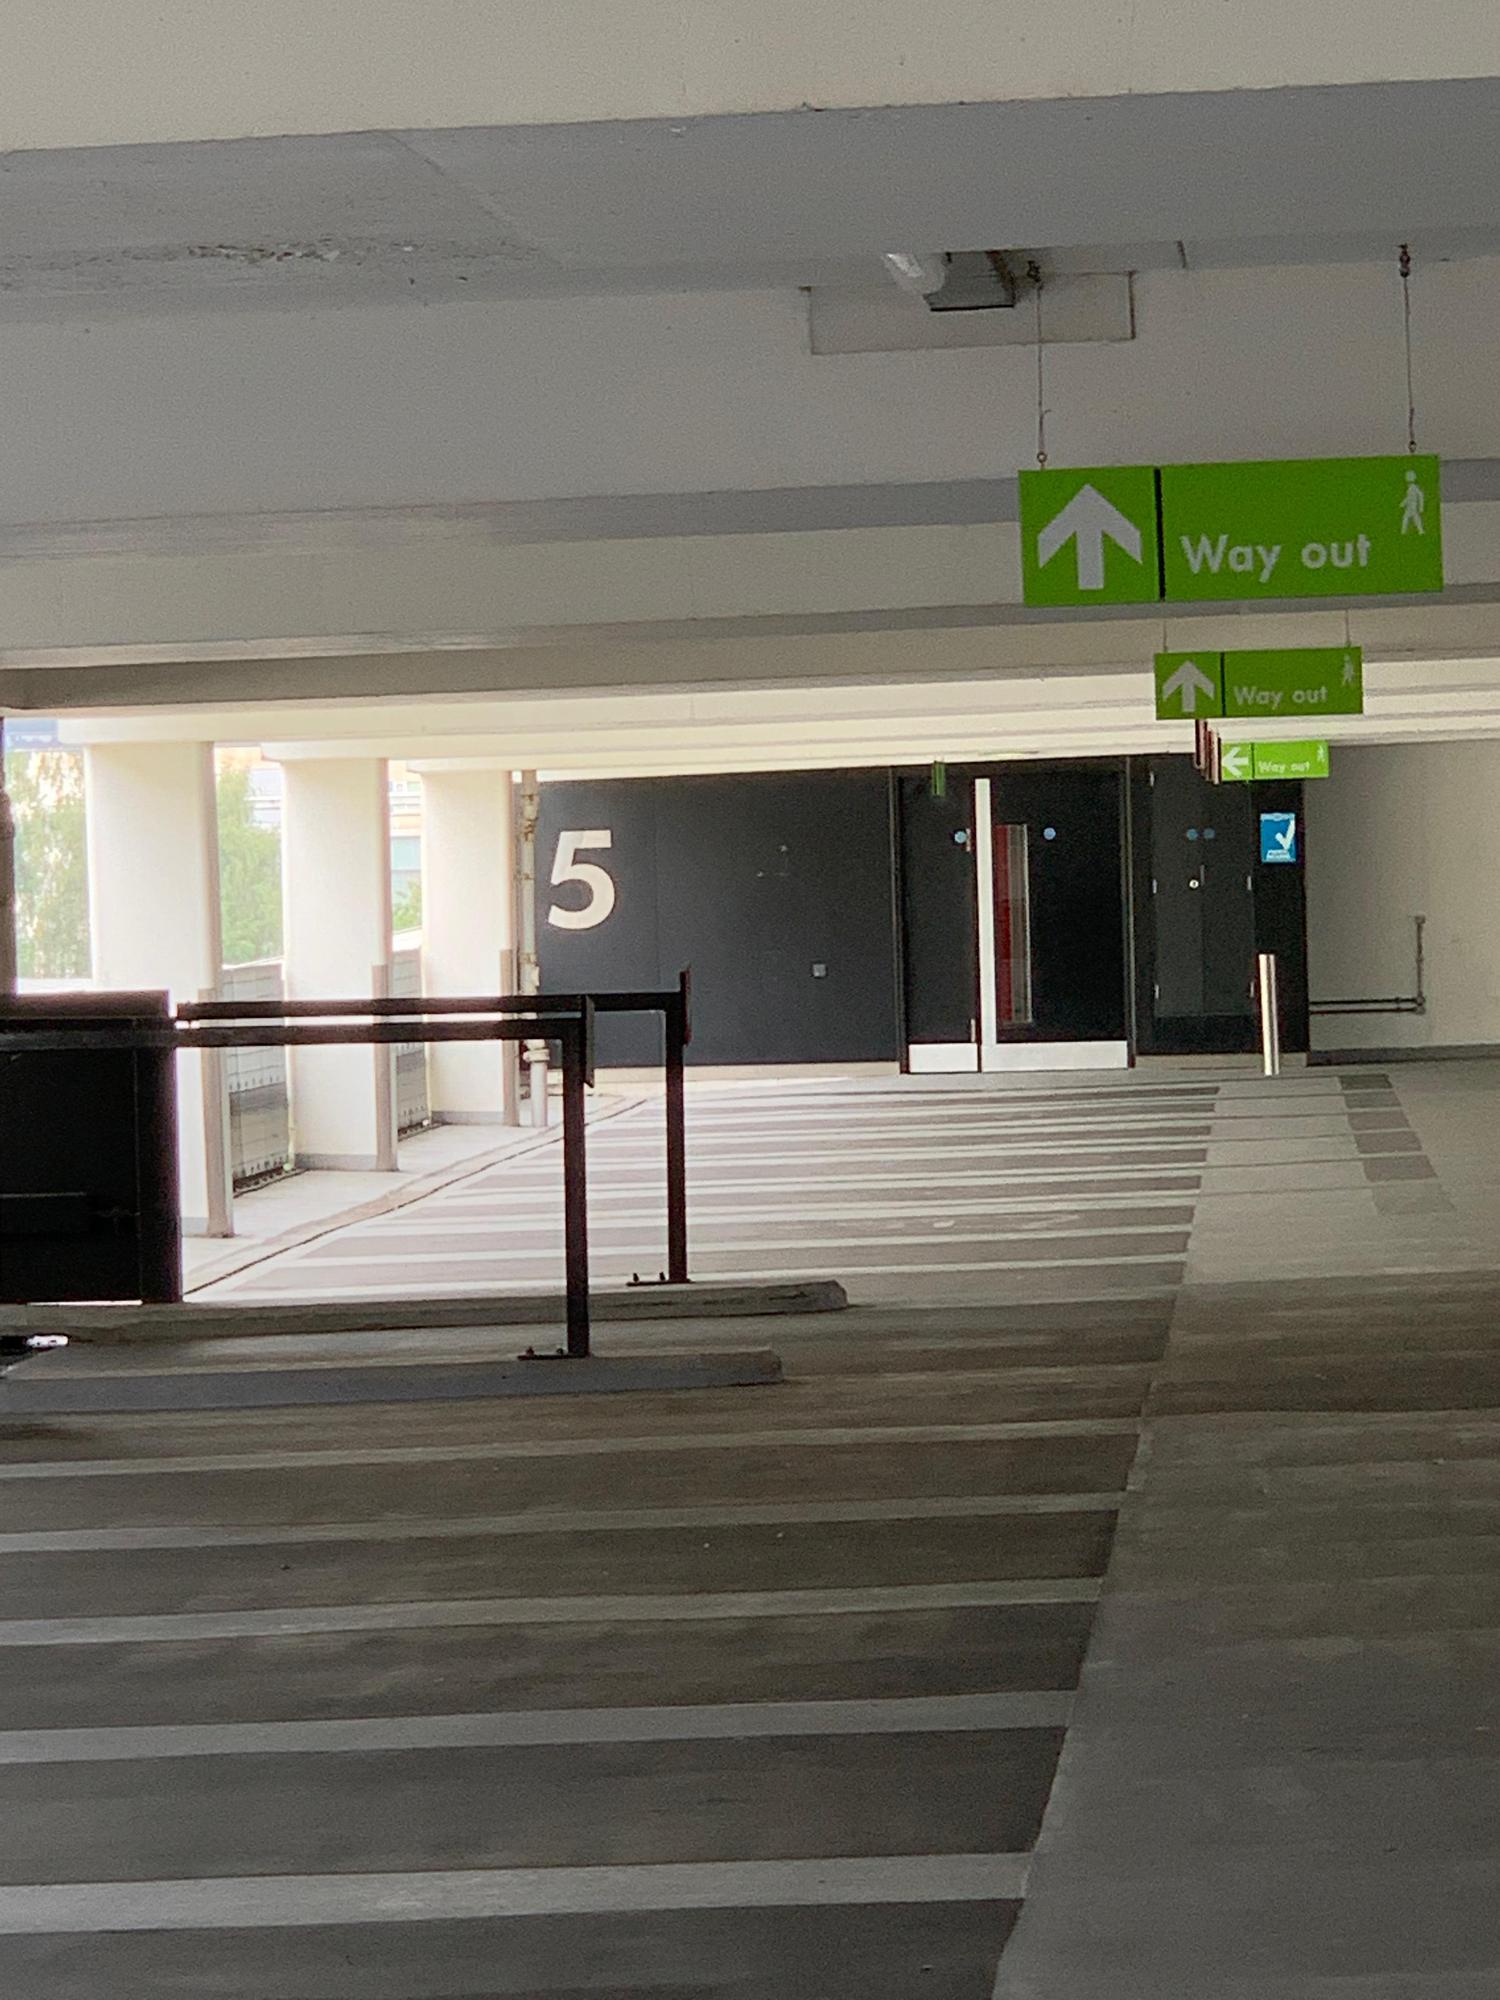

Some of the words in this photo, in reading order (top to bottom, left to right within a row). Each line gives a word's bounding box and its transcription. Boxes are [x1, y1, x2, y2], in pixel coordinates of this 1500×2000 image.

[1179, 533, 1281, 584] Way
[1301, 533, 1371, 569] out
[1233, 685, 1283, 710] Way
[1292, 684, 1328, 703] out
[1258, 760, 1286, 773] Way
[1291, 760, 1310, 772] out
[547, 829, 616, 930] 5
